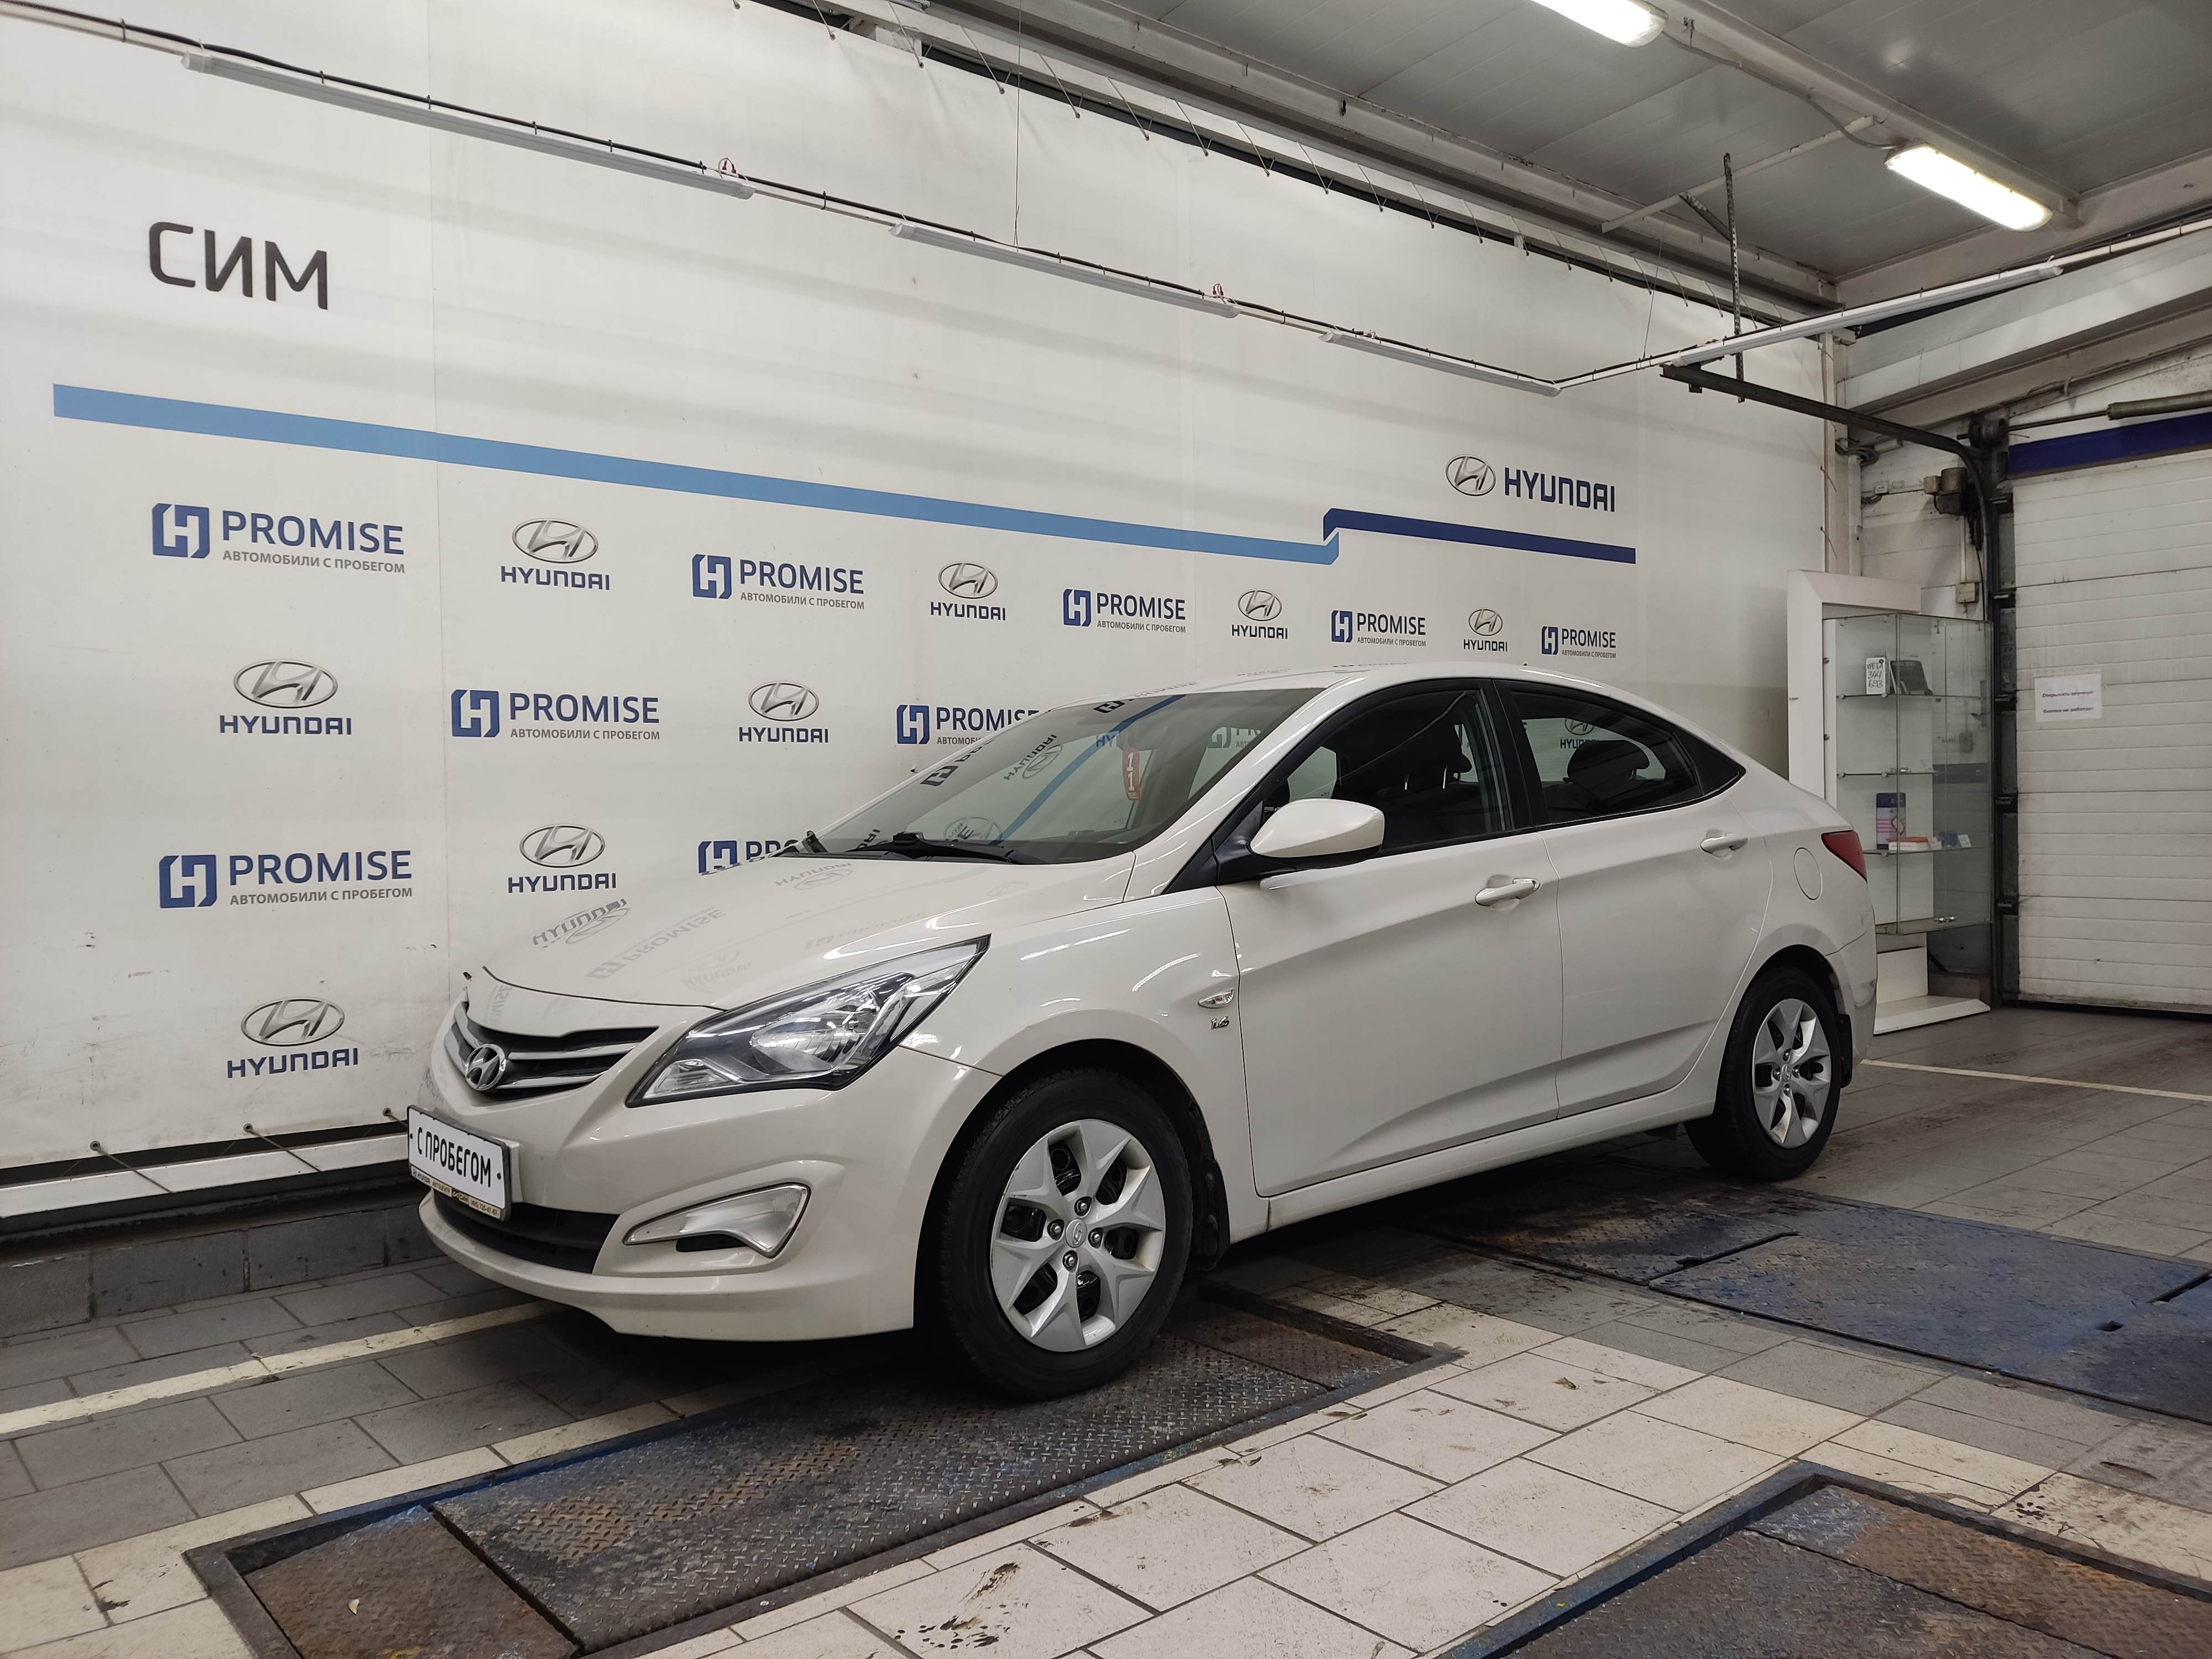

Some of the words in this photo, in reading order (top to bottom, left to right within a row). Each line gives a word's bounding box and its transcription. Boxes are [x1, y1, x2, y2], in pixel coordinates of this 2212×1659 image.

[149, 221, 328, 310] СИМ
[1505, 467, 1615, 513] HYUNDAI
[222, 510, 405, 556] PROMISE
[222, 550, 320, 567] АВТОМОБИЛИ
[323, 558, 331, 568] С
[335, 559, 405, 573] ПРОБЕГОМ
[500, 566, 610, 591] HYUNDAI
[739, 559, 864, 594] PROMISE
[740, 592, 807, 605] АВТОМОБИЛИ
[808, 597, 815, 606] С
[816, 598, 864, 609] ПРОБЕГОМ
[930, 601, 1006, 621] HYUNDAI
[1097, 592, 1186, 620] PROMISE
[1097, 620, 1145, 630] АВТОМОБИЛИ
[1151, 624, 1186, 633] ПРОБЕГОМ
[1232, 624, 1288, 640] HYUNDAI
[1357, 612, 1426, 635] PROMISE
[1357, 637, 1394, 645] АВТОМОБИЛИ
[1463, 639, 1507, 652] HYUNDAI
[1562, 628, 1616, 649] PROMISE
[509, 692, 660, 723] PROMISE
[220, 715, 352, 735] HYUNDAI
[510, 728, 590, 739] АВТОМОБИЛИ
[593, 730, 600, 739] С
[603, 730, 660, 740] ПРОБЕГОМ
[739, 727, 828, 743] HYUNDAI
[229, 850, 412, 886] PROMISE
[508, 873, 616, 894] HYUNDAI
[229, 891, 327, 905] АВТОМОБИЛИ
[330, 890, 338, 900] С
[342, 888, 412, 900] ПРОБЕГОМ
[227, 1047, 358, 1078] HYUNDAI
[417, 1126, 423, 1155] С
[425, 1130, 491, 1188] ПРОБЕГОМ
